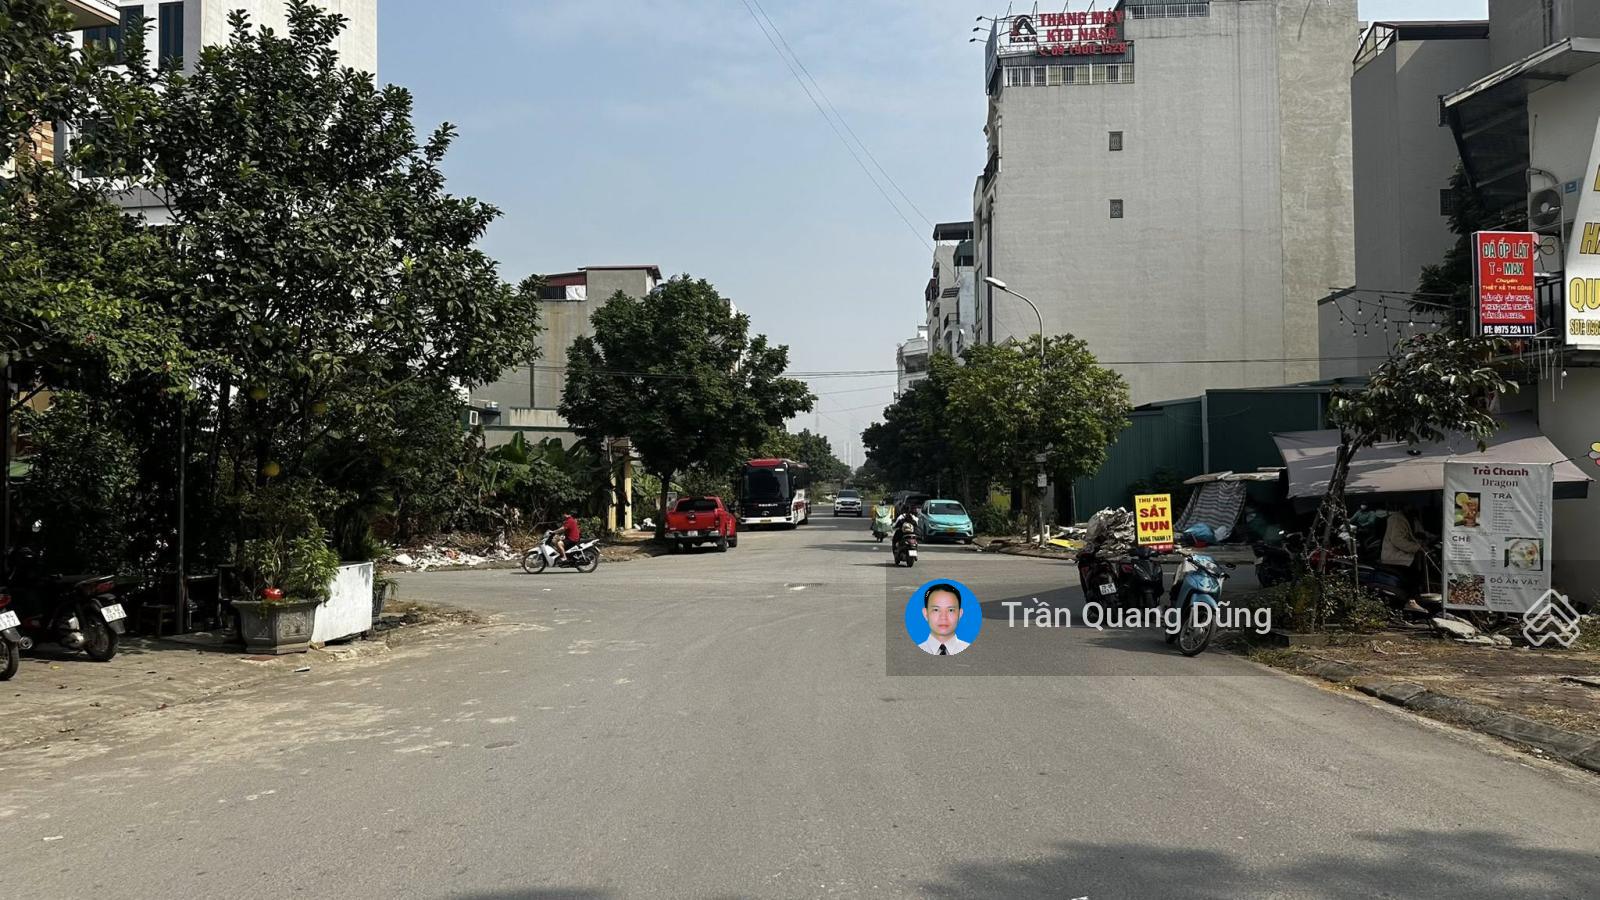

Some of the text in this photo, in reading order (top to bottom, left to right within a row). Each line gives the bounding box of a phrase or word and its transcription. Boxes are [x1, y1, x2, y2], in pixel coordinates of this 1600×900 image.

[1039, 8, 1123, 26] THANG MÁY
[1078, 27, 1117, 41] NASA
[1483, 237, 1530, 259] ĐÁ ỐP LÁT
[1489, 262, 1495, 275] T
[1504, 262, 1524, 275] MAX
[1494, 325, 1509, 334] 0975
[1510, 325, 1521, 334] 224
[1522, 325, 1533, 334] 111
[1472, 466, 1529, 476] Trà Chanh
[1482, 478, 1519, 488] Dragon
[1139, 504, 1166, 517] SẮT
[1140, 521, 1169, 532] VỤN
